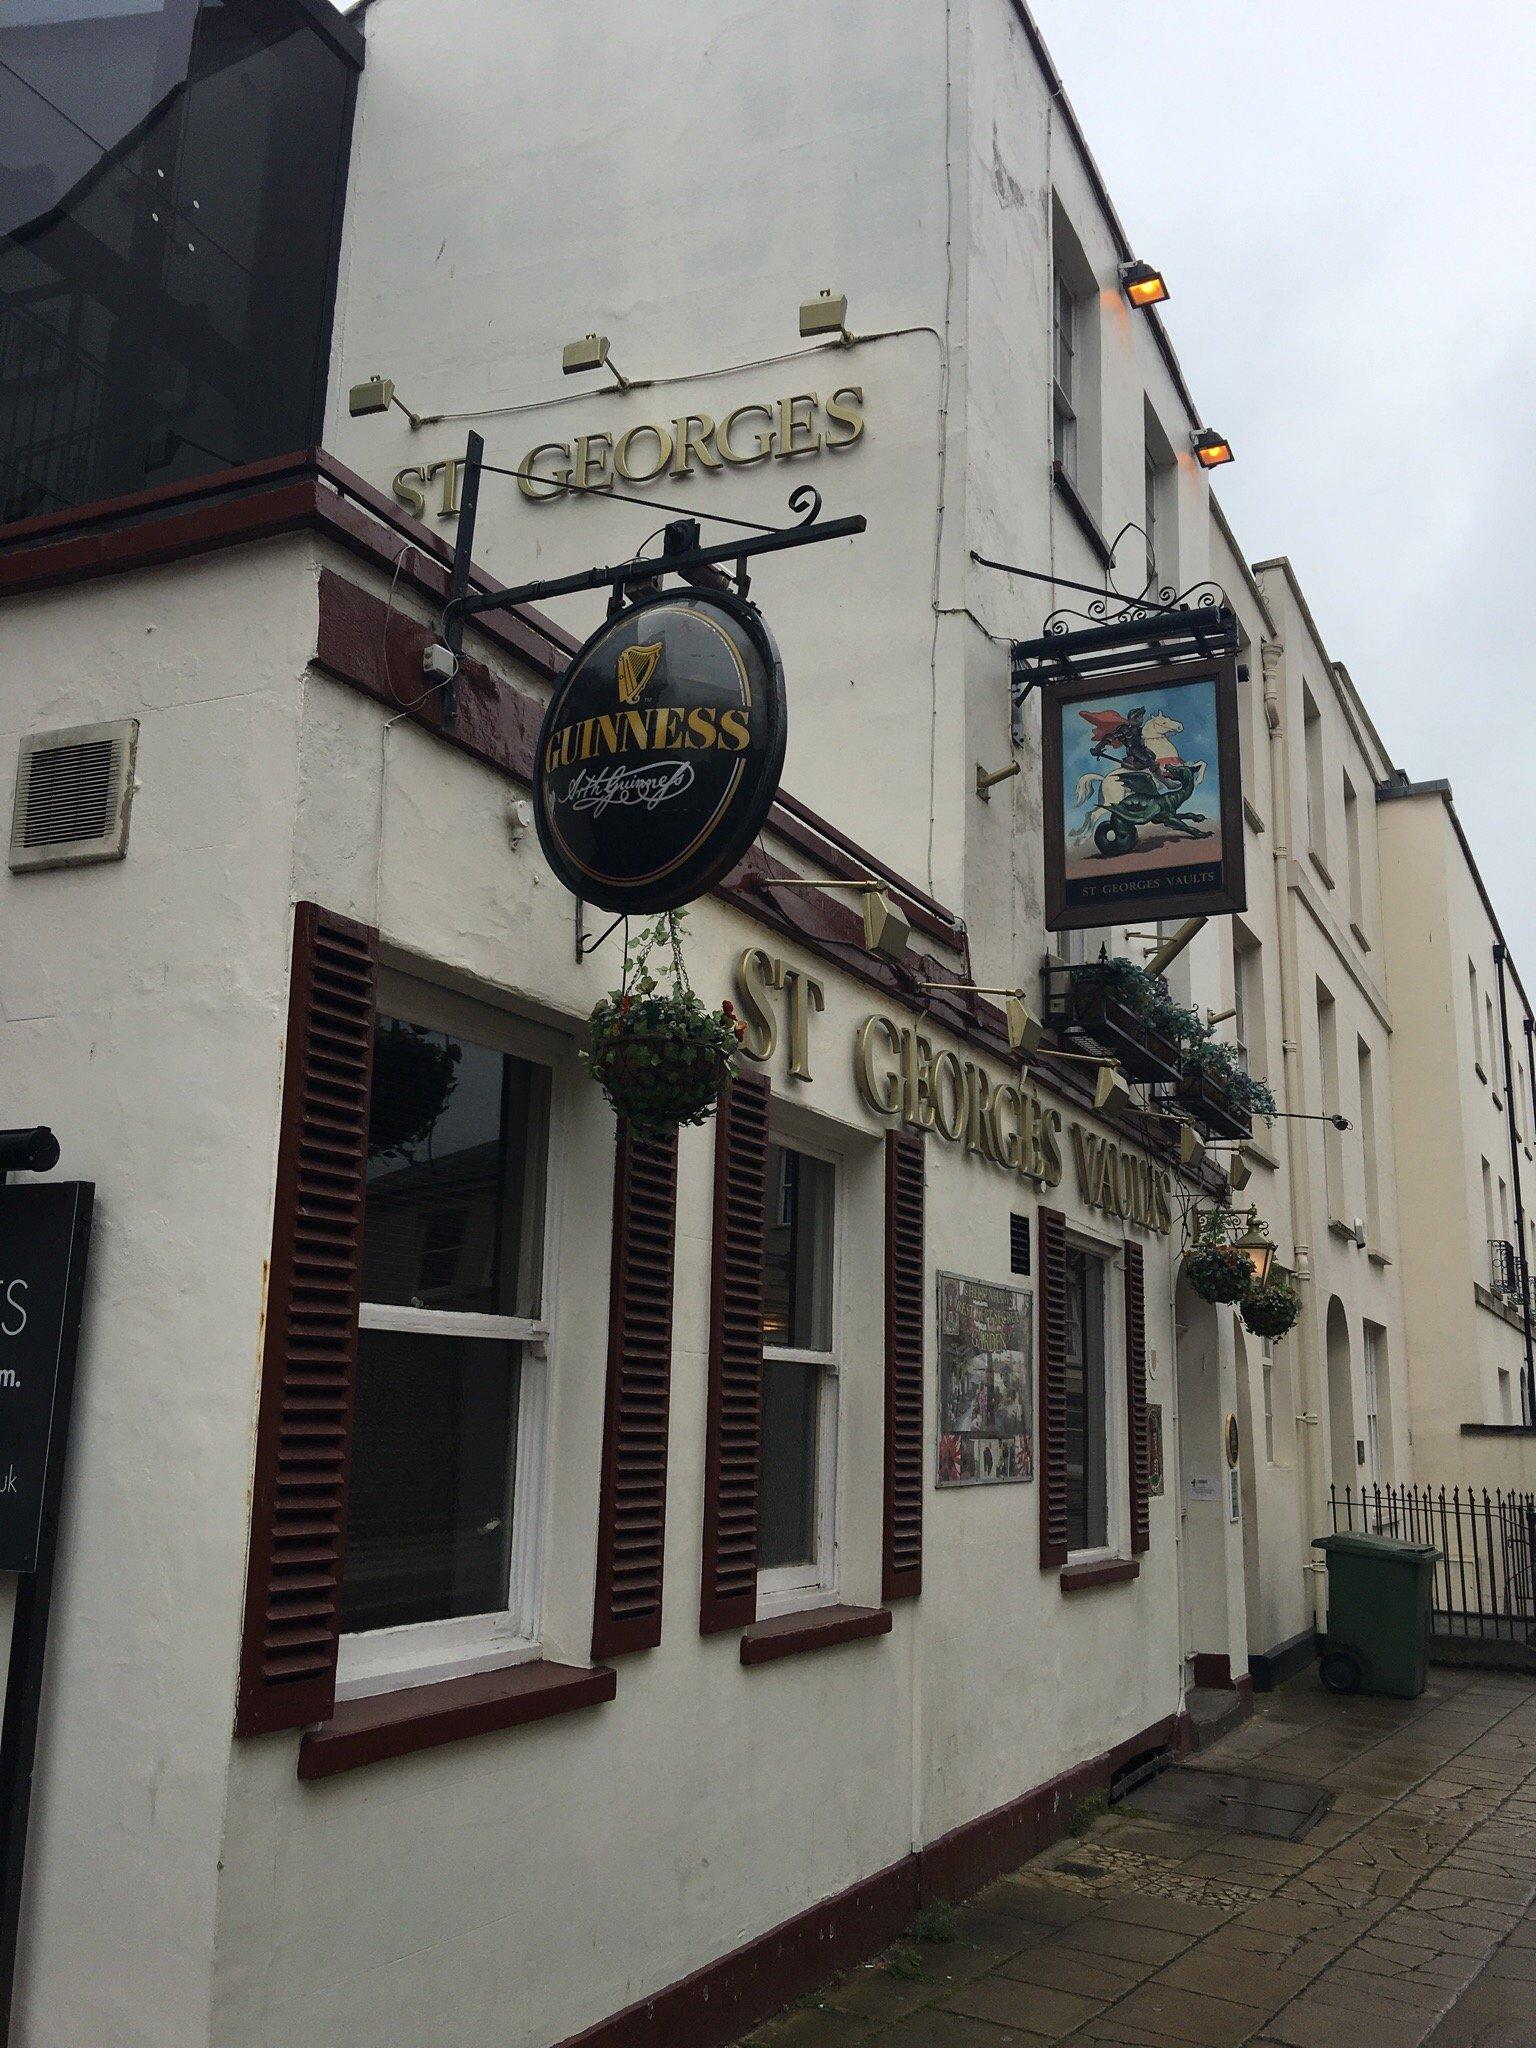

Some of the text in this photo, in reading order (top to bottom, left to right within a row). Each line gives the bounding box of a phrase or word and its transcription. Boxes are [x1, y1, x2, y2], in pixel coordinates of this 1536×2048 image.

[392, 386, 865, 518] ST GEORGES
[545, 707, 751, 773] GUINNESS
[1082, 871, 1214, 897] ST GEORGES VAULTS
[738, 946, 825, 1082] ST
[857, 1013, 1062, 1188] GEORGES
